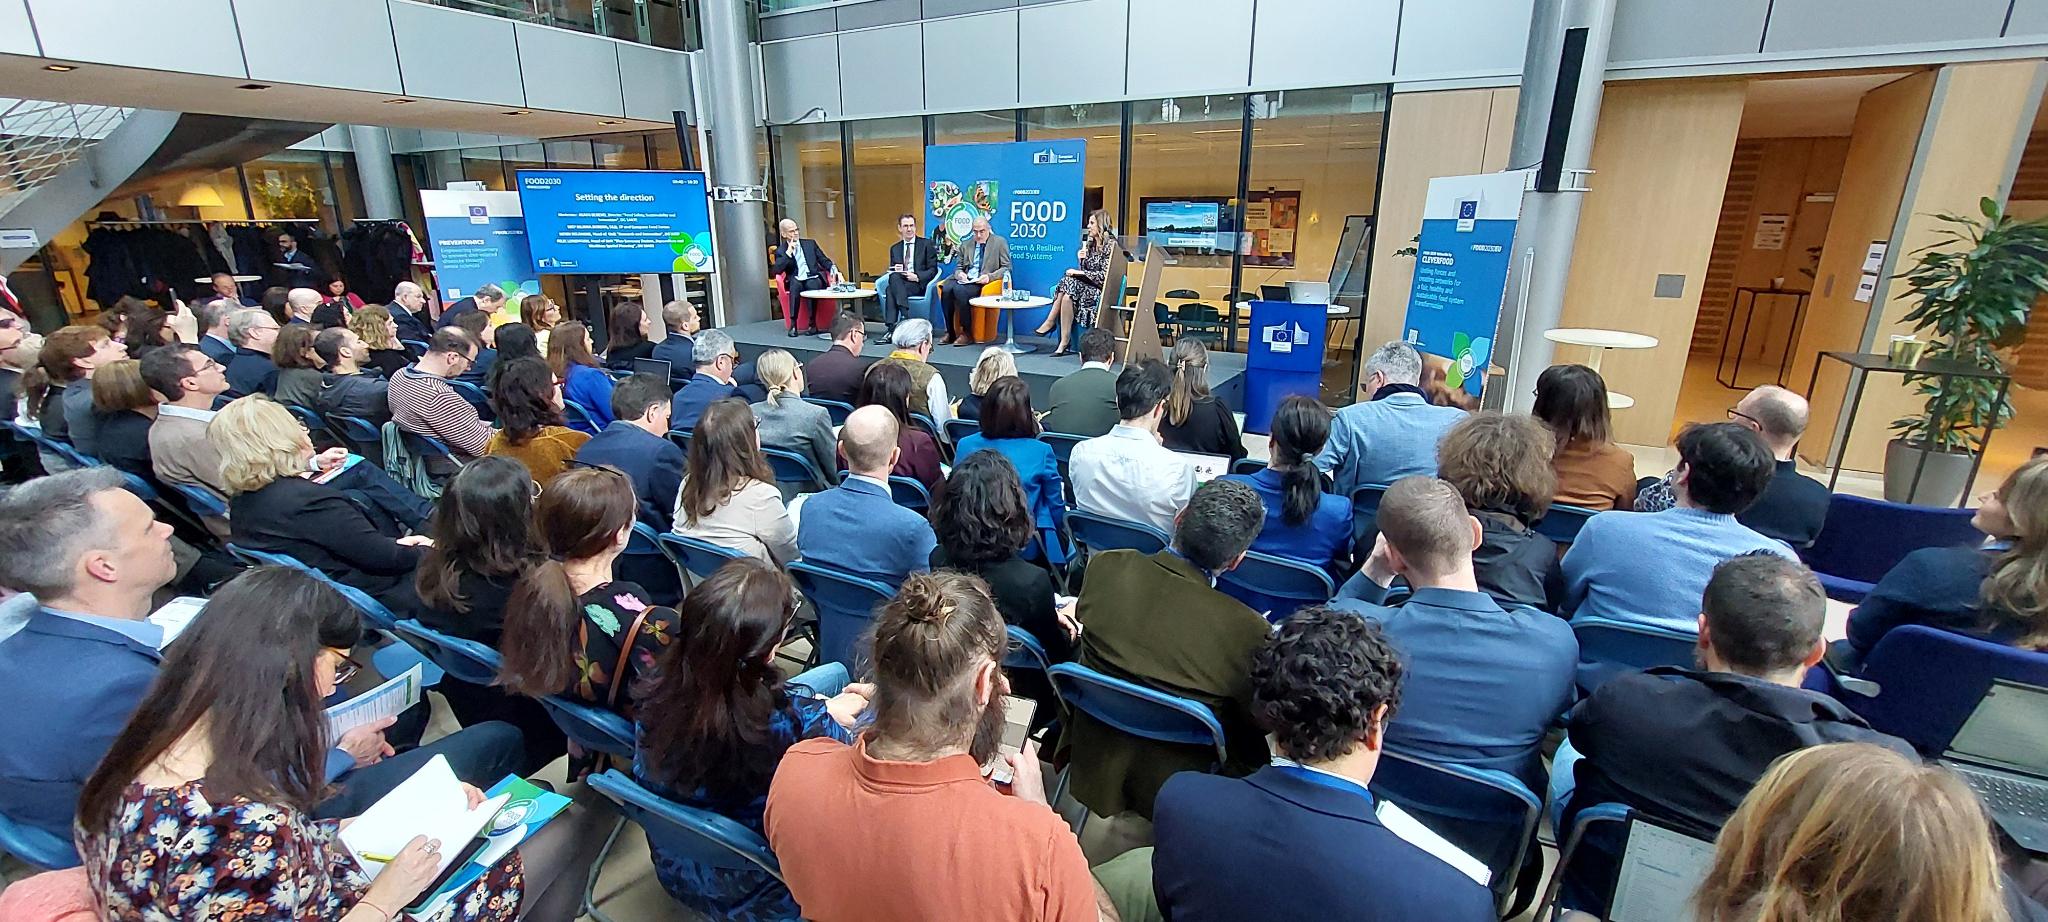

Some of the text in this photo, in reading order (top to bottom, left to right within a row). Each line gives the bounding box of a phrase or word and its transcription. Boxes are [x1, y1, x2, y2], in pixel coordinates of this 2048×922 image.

[575, 193, 604, 202] Setting
[1010, 201, 1067, 222] FOOD
[1010, 223, 1047, 238] 2030
[1036, 244, 1064, 252] Resilient
[1009, 252, 1053, 260] Food Systems
[1421, 256, 1454, 266] CLEVERFOOD
